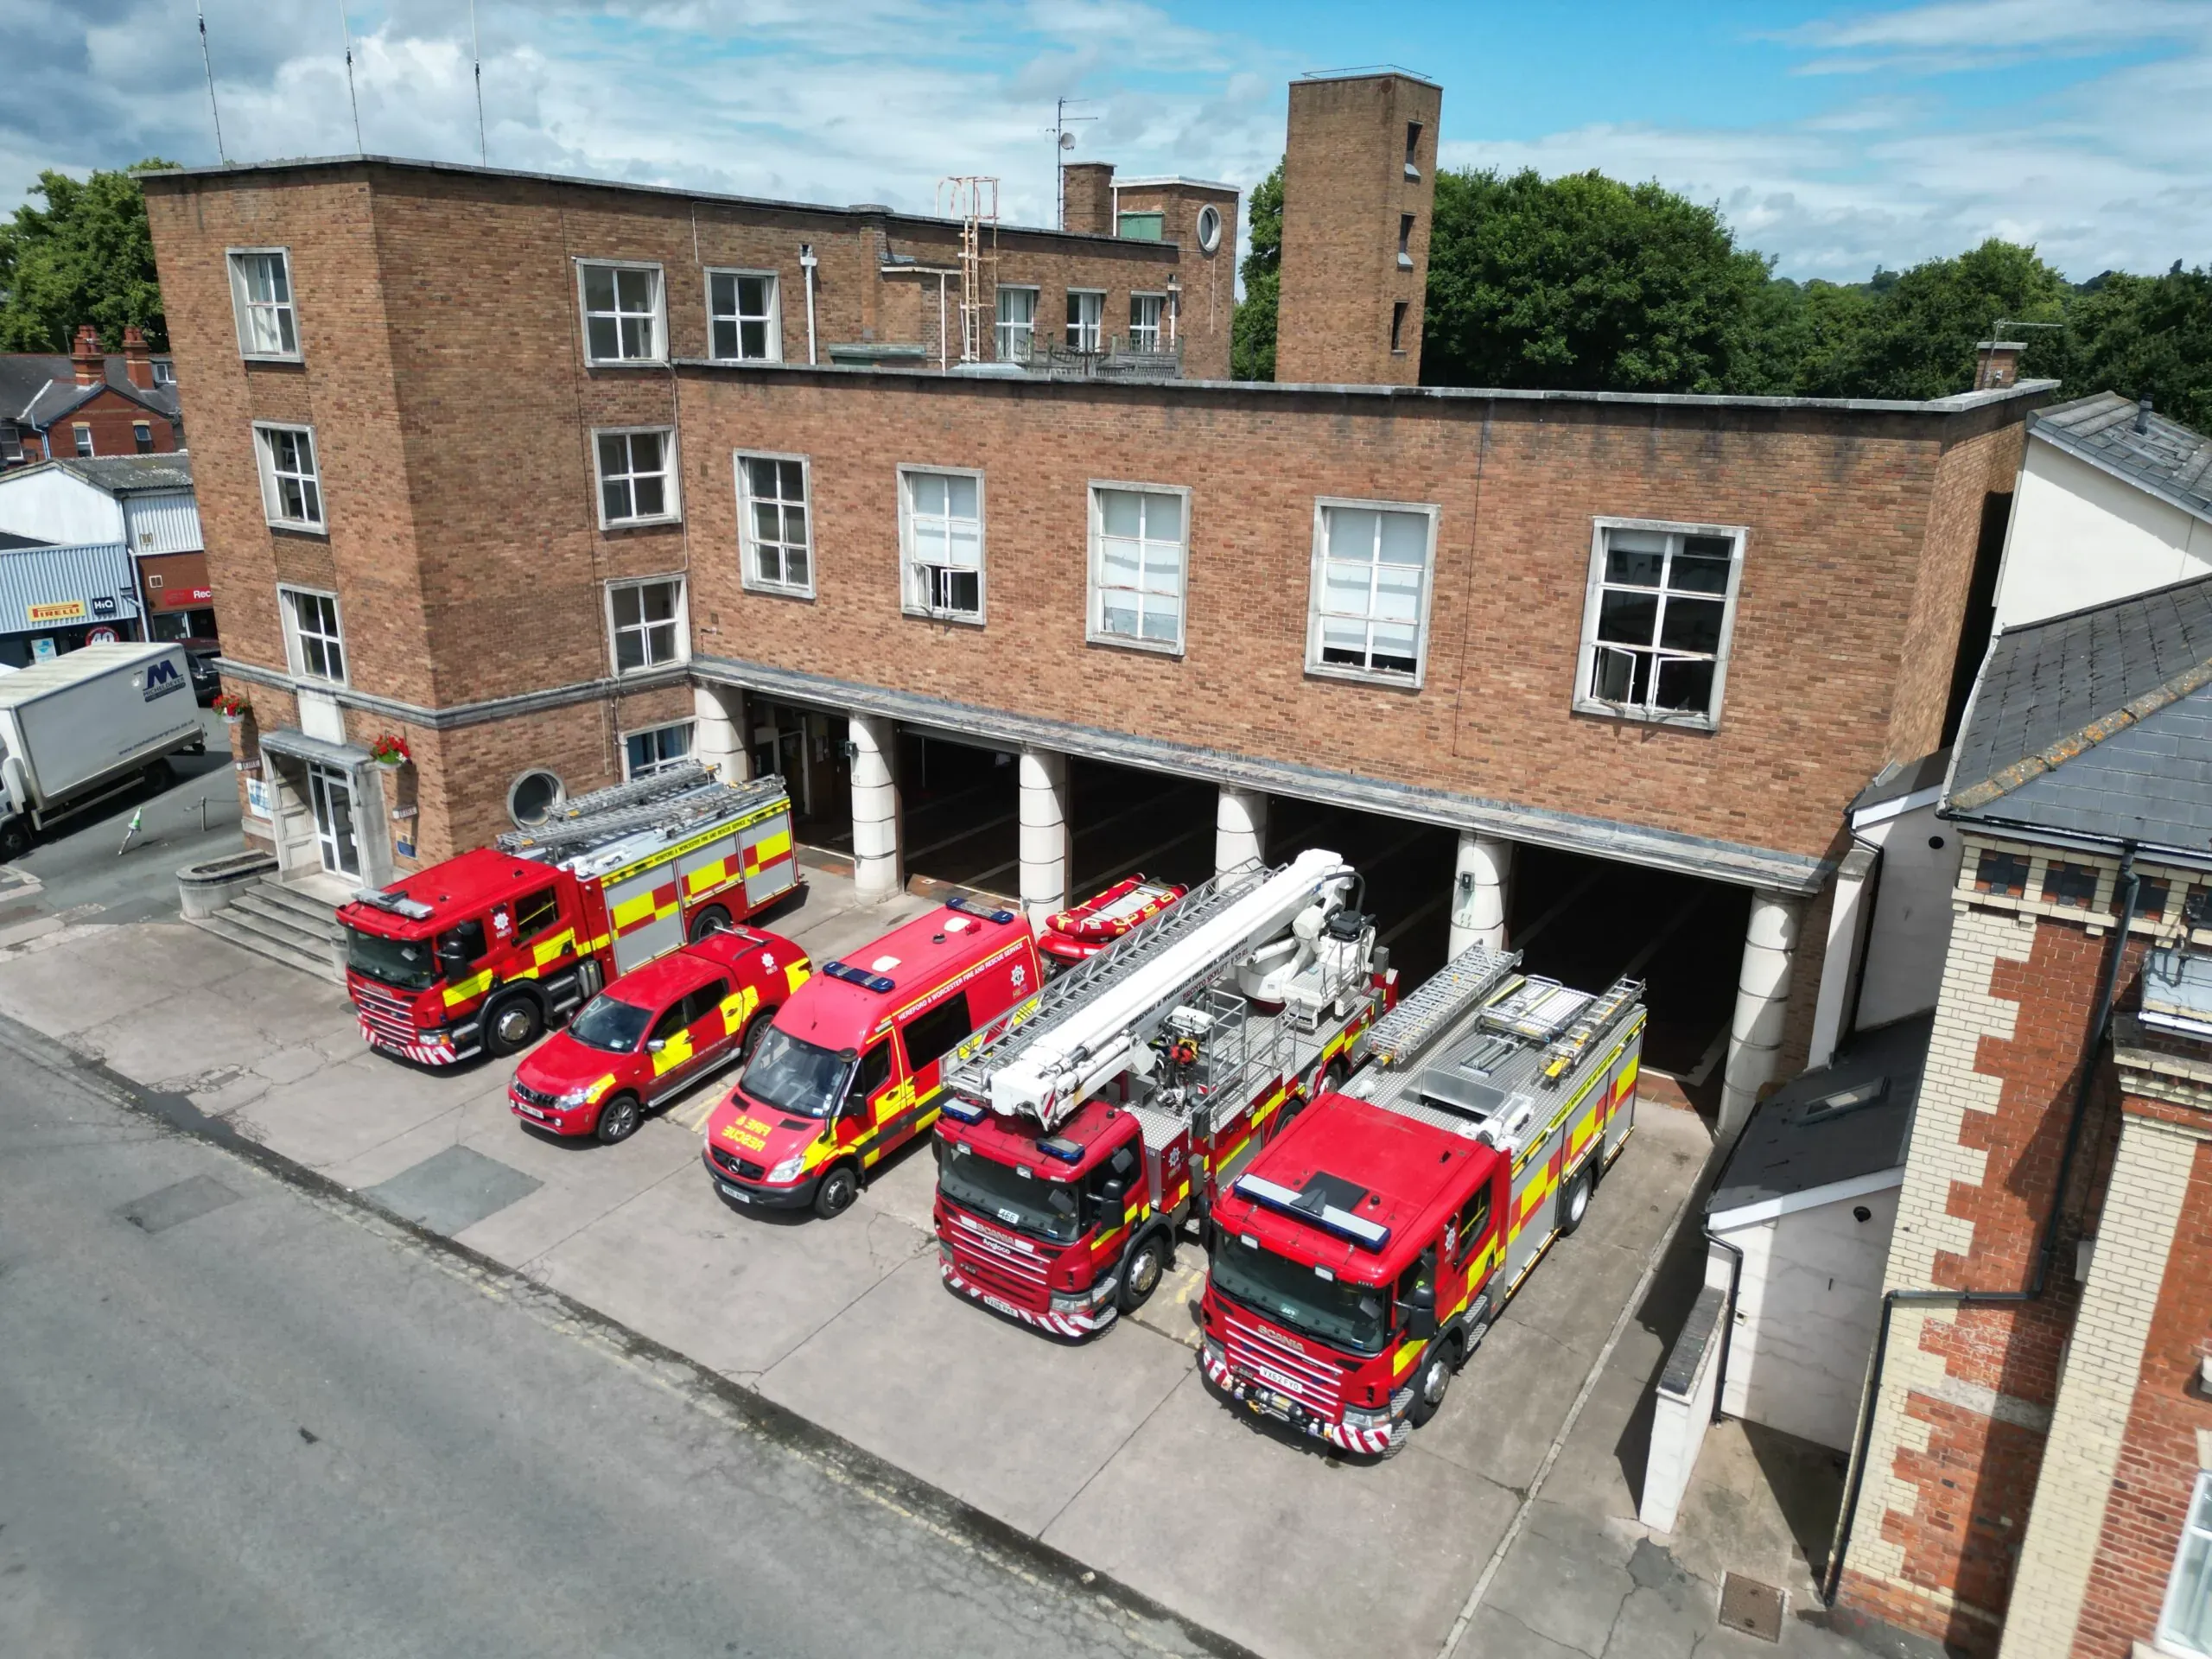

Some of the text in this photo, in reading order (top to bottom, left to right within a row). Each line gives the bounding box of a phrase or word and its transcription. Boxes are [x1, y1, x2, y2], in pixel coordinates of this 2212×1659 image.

[32, 604, 79, 618] PIRELLI
[94, 600, 113, 609] HiQ
[147, 659, 178, 689] M
[717, 826, 731, 836] RESCUE
[731, 820, 746, 830] SERVICE
[898, 1000, 927, 1021] HEREFORD
[931, 977, 963, 1001] WORCESTER
[963, 971, 975, 982] FIRE
[974, 964, 985, 975] AND
[985, 953, 1004, 969] RESCUE
[1004, 943, 1023, 957] SERVICE
[1182, 978, 1206, 1001] BRONTO
[1206, 961, 1228, 983] SKYLIFT
[976, 1223, 1015, 1244] SCANIA
[982, 1238, 1011, 1255] Angloco
[1258, 1325, 1306, 1353] SCANIA
[1263, 1368, 1283, 1382] VX62
